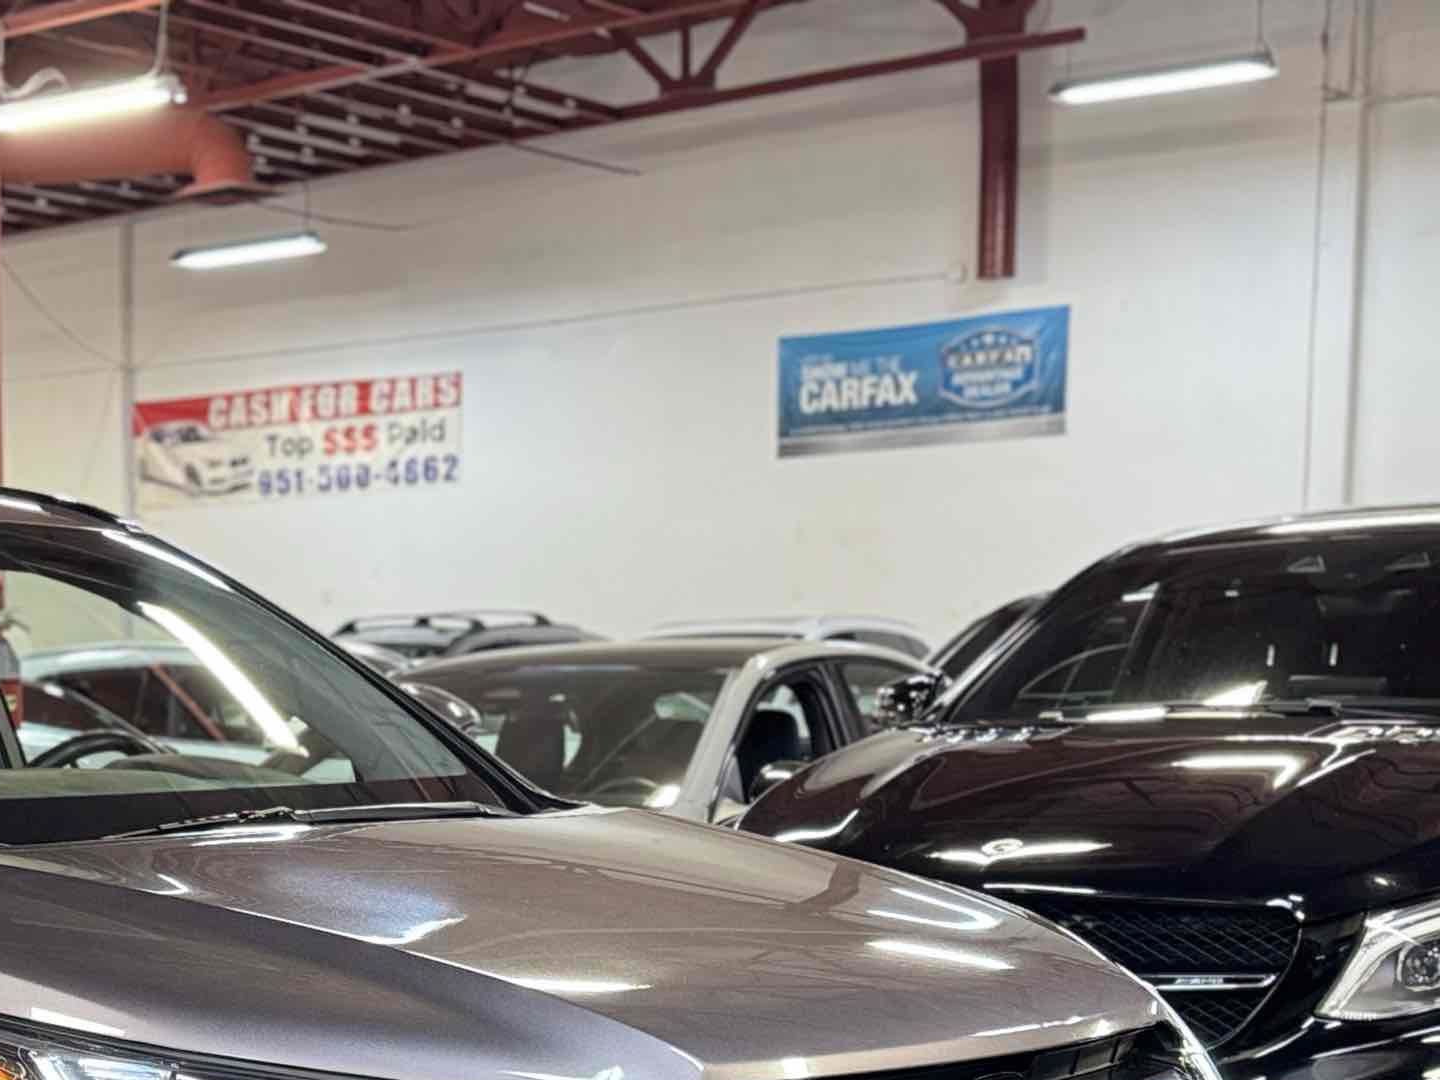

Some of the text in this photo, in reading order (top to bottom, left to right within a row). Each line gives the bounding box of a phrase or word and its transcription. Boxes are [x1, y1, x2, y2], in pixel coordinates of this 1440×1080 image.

[208, 375, 461, 431] CASH FOR CARS
[799, 371, 919, 415] CARFAX
[265, 433, 314, 460] Top
[387, 418, 446, 445] Paid
